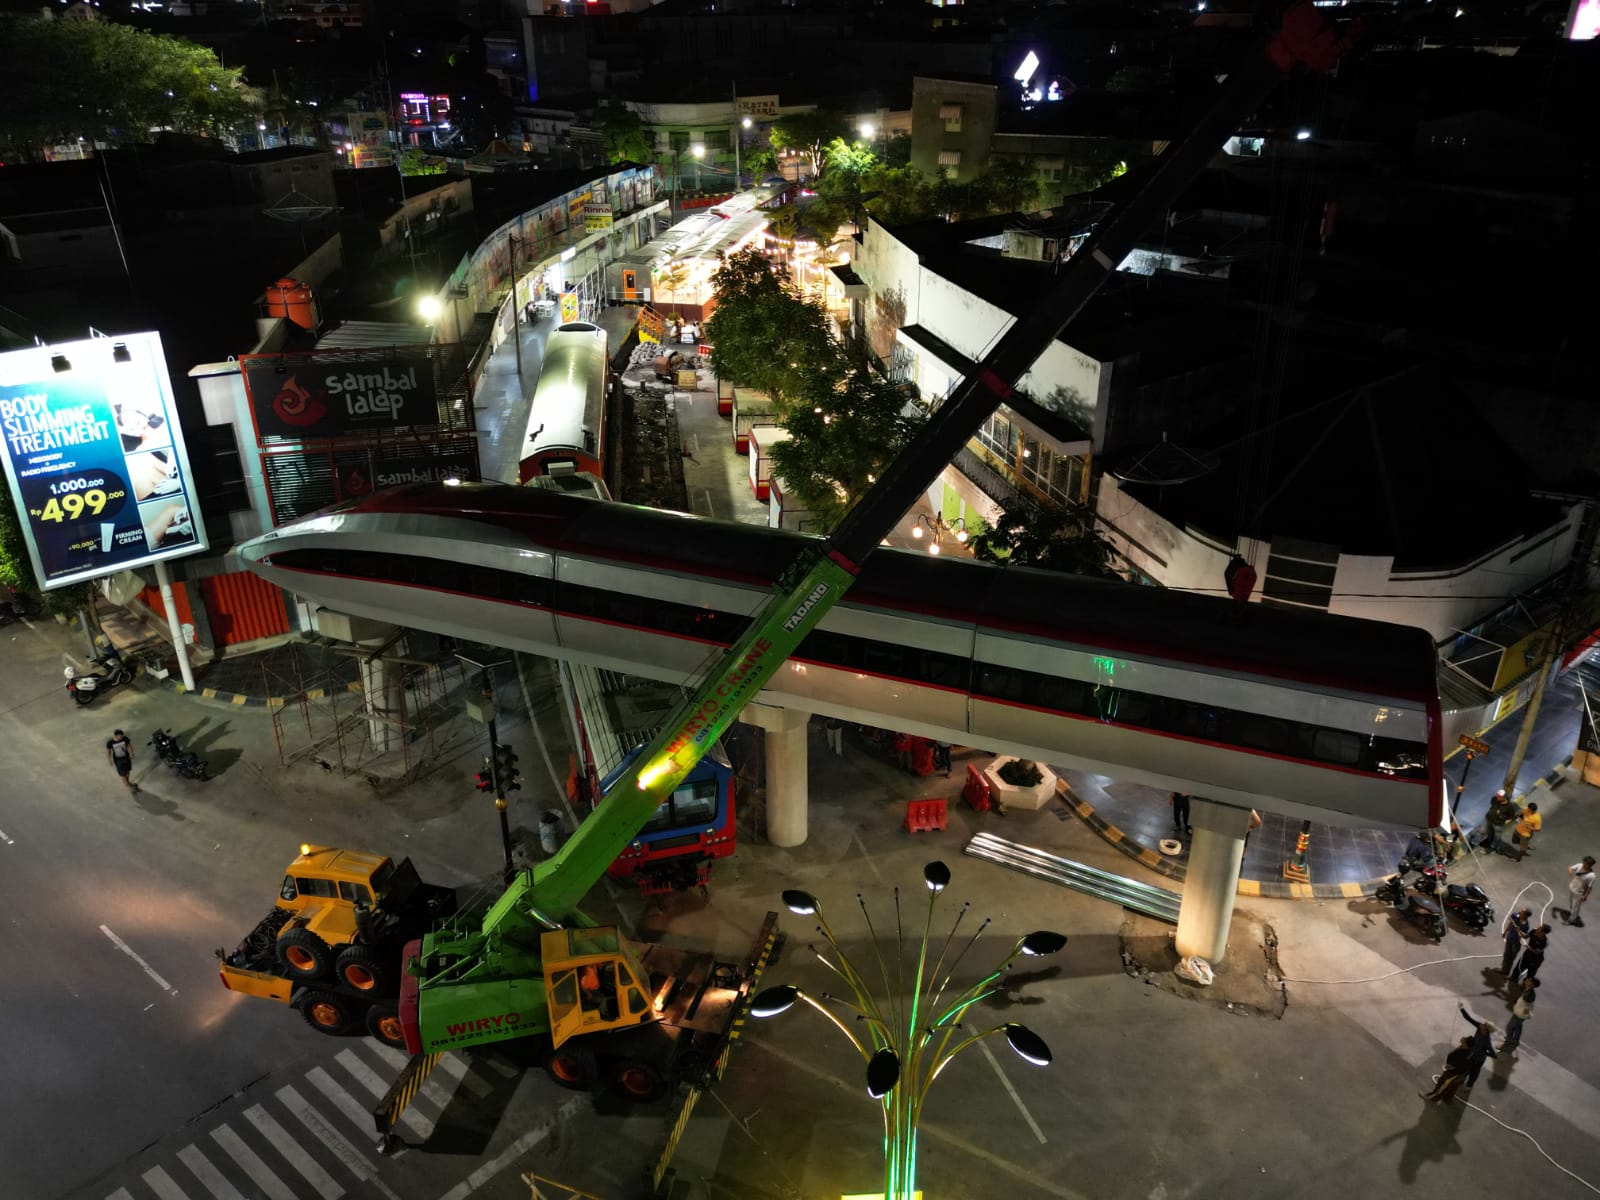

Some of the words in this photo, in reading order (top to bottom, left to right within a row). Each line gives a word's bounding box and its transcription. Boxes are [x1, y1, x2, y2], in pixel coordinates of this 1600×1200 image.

[1, 393, 48, 420] BODY
[4, 405, 95, 438] SLIMMING
[8, 421, 109, 455] TREATMENT
[115, 528, 143, 540] FIRMING
[119, 535, 143, 545] CREAM
[785, 583, 828, 631] TADANO
[665, 699, 718, 753] WIRYO
[717, 637, 773, 697] CRANE
[446, 1012, 520, 1036] WIRYO
